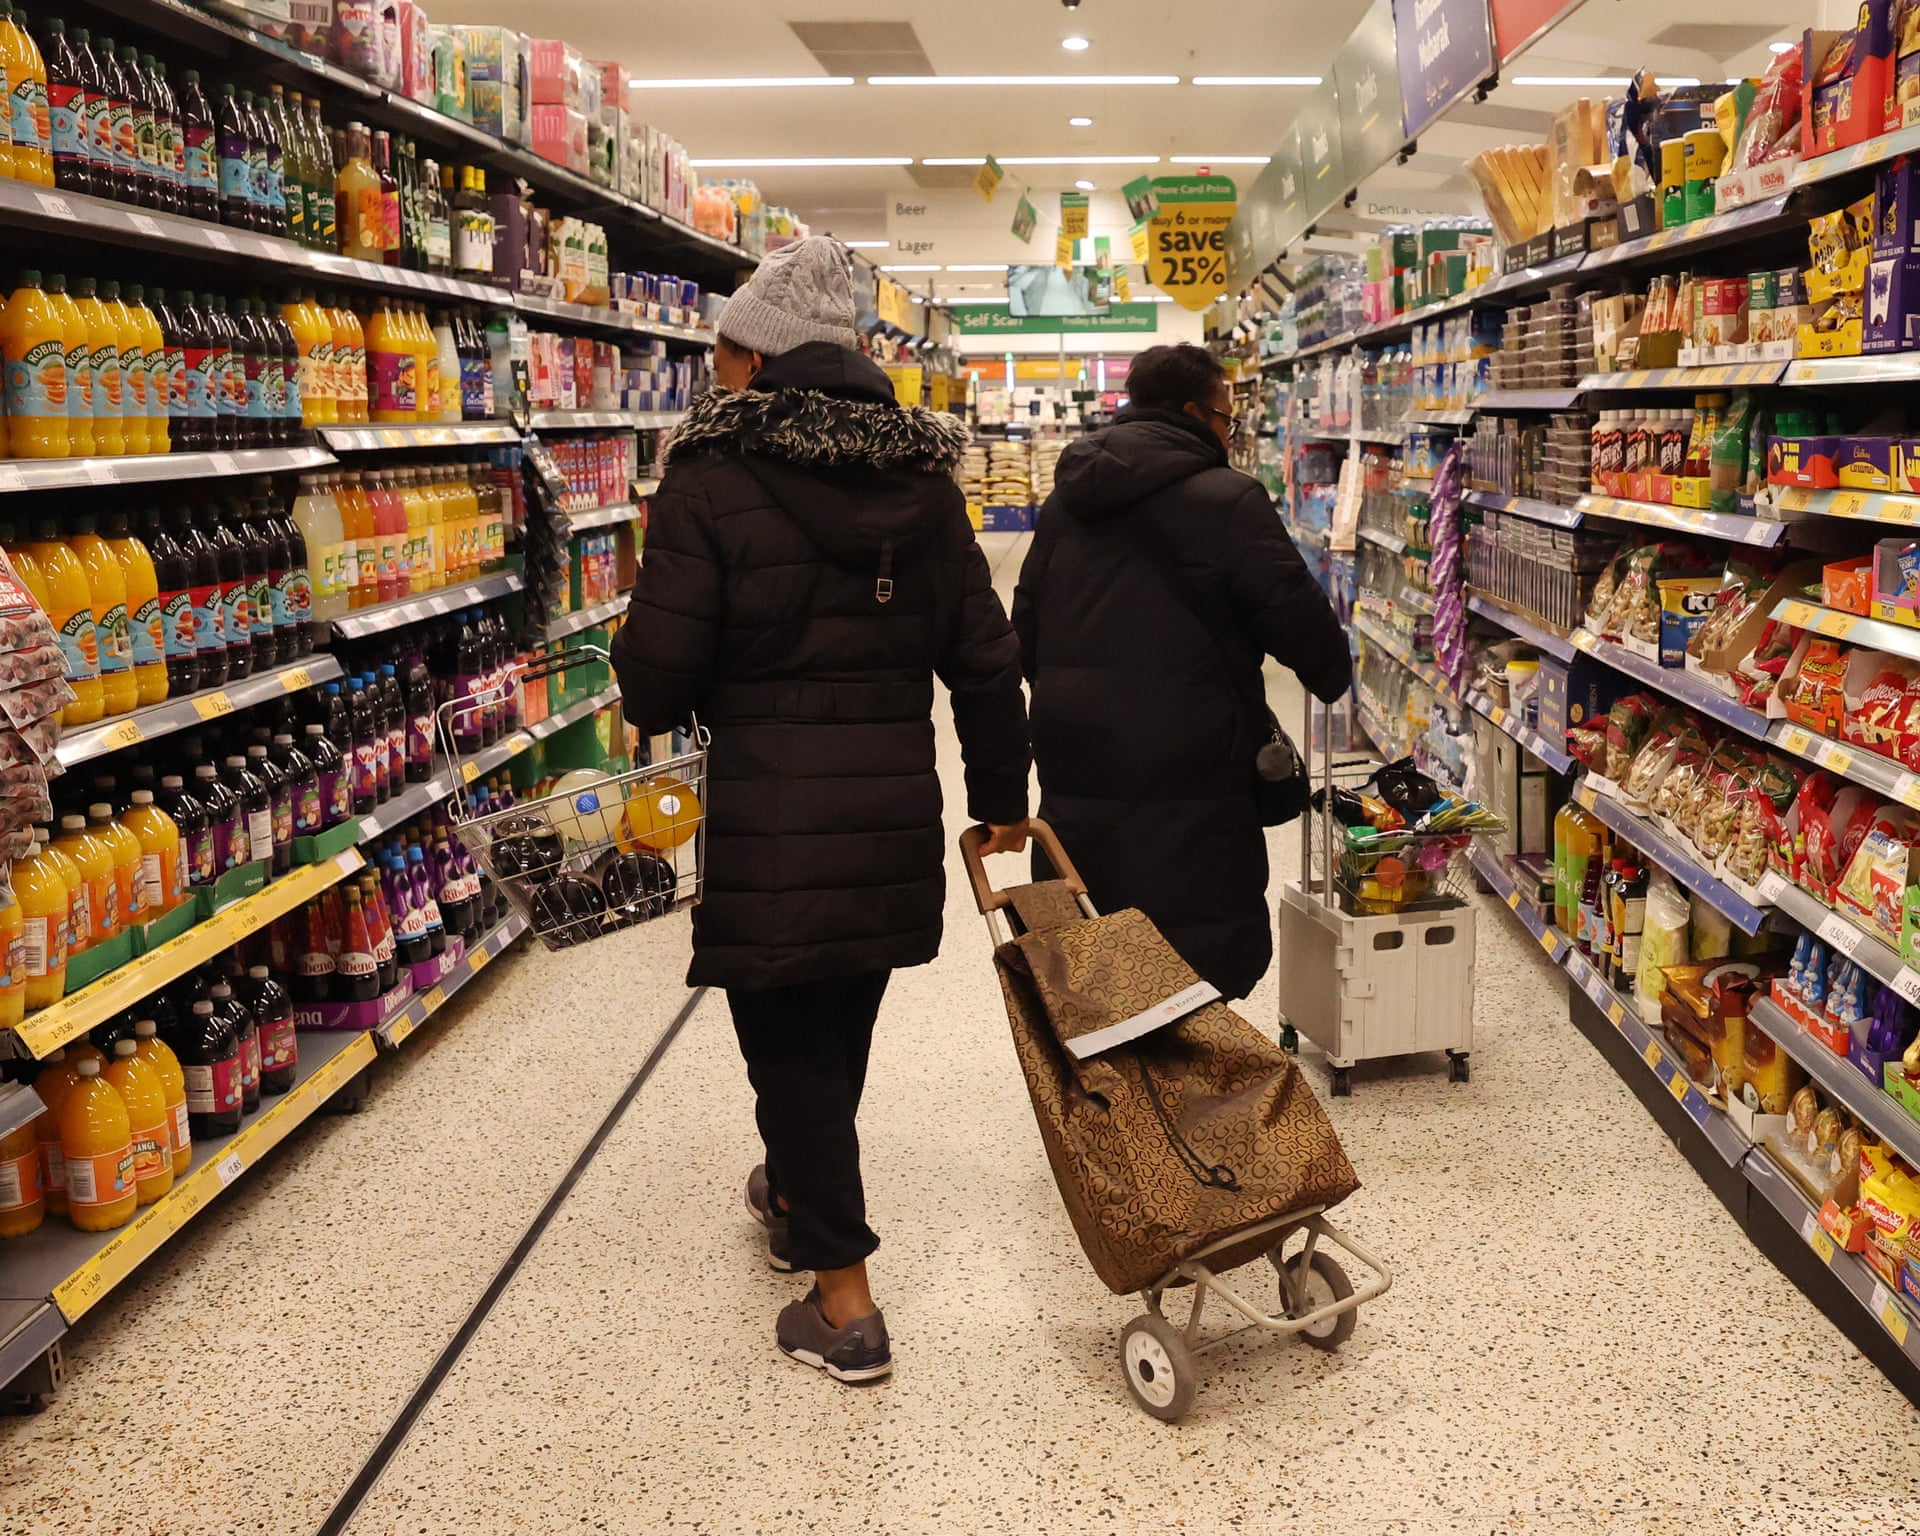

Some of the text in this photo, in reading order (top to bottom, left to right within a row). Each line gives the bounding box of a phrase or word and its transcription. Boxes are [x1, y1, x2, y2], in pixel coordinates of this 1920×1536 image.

[1180, 184, 1205, 194] Card
[1206, 184, 1231, 194] Price
[895, 202, 926, 216] Beer
[1176, 211, 1185, 225] 6
[1189, 217, 1200, 225] or
[898, 239, 934, 255] Lager
[1158, 230, 1225, 252] save
[1162, 256, 1225, 285] 25%
[963, 314, 989, 327] Self
